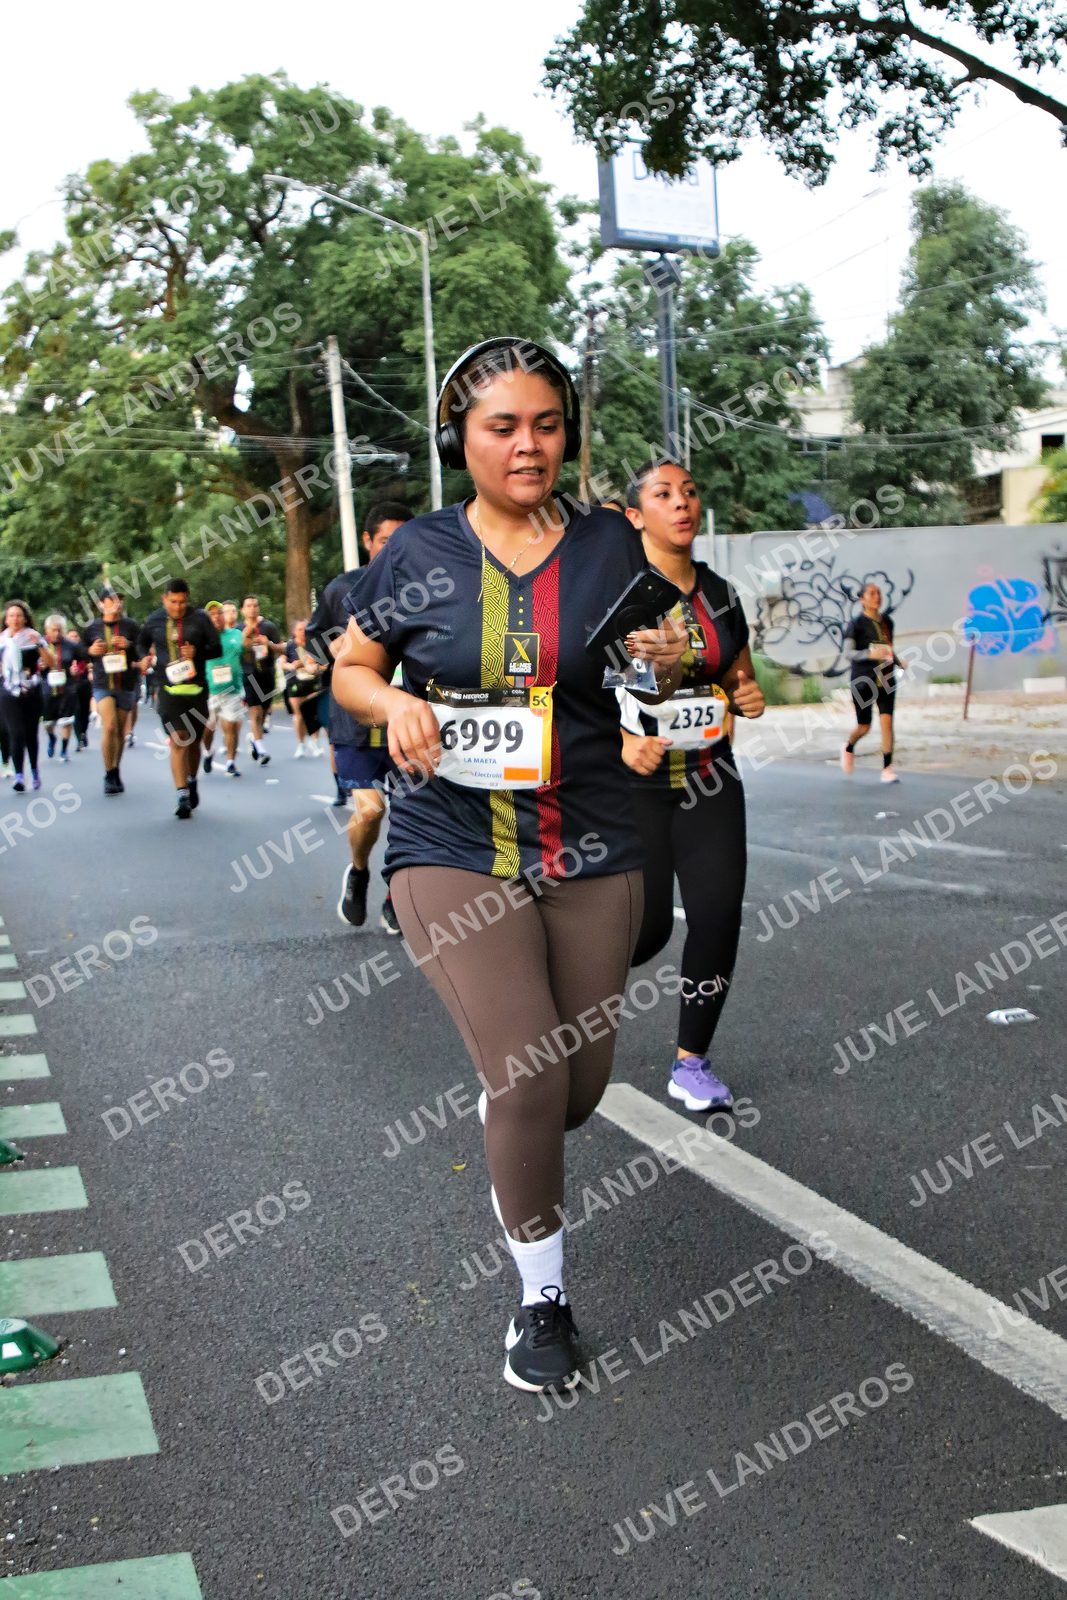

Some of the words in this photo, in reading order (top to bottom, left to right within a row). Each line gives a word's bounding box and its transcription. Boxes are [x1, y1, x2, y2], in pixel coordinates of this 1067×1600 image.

[532, 695, 548, 707] 5K
[669, 705, 715, 730] 2325
[440, 718, 524, 753] 6999
